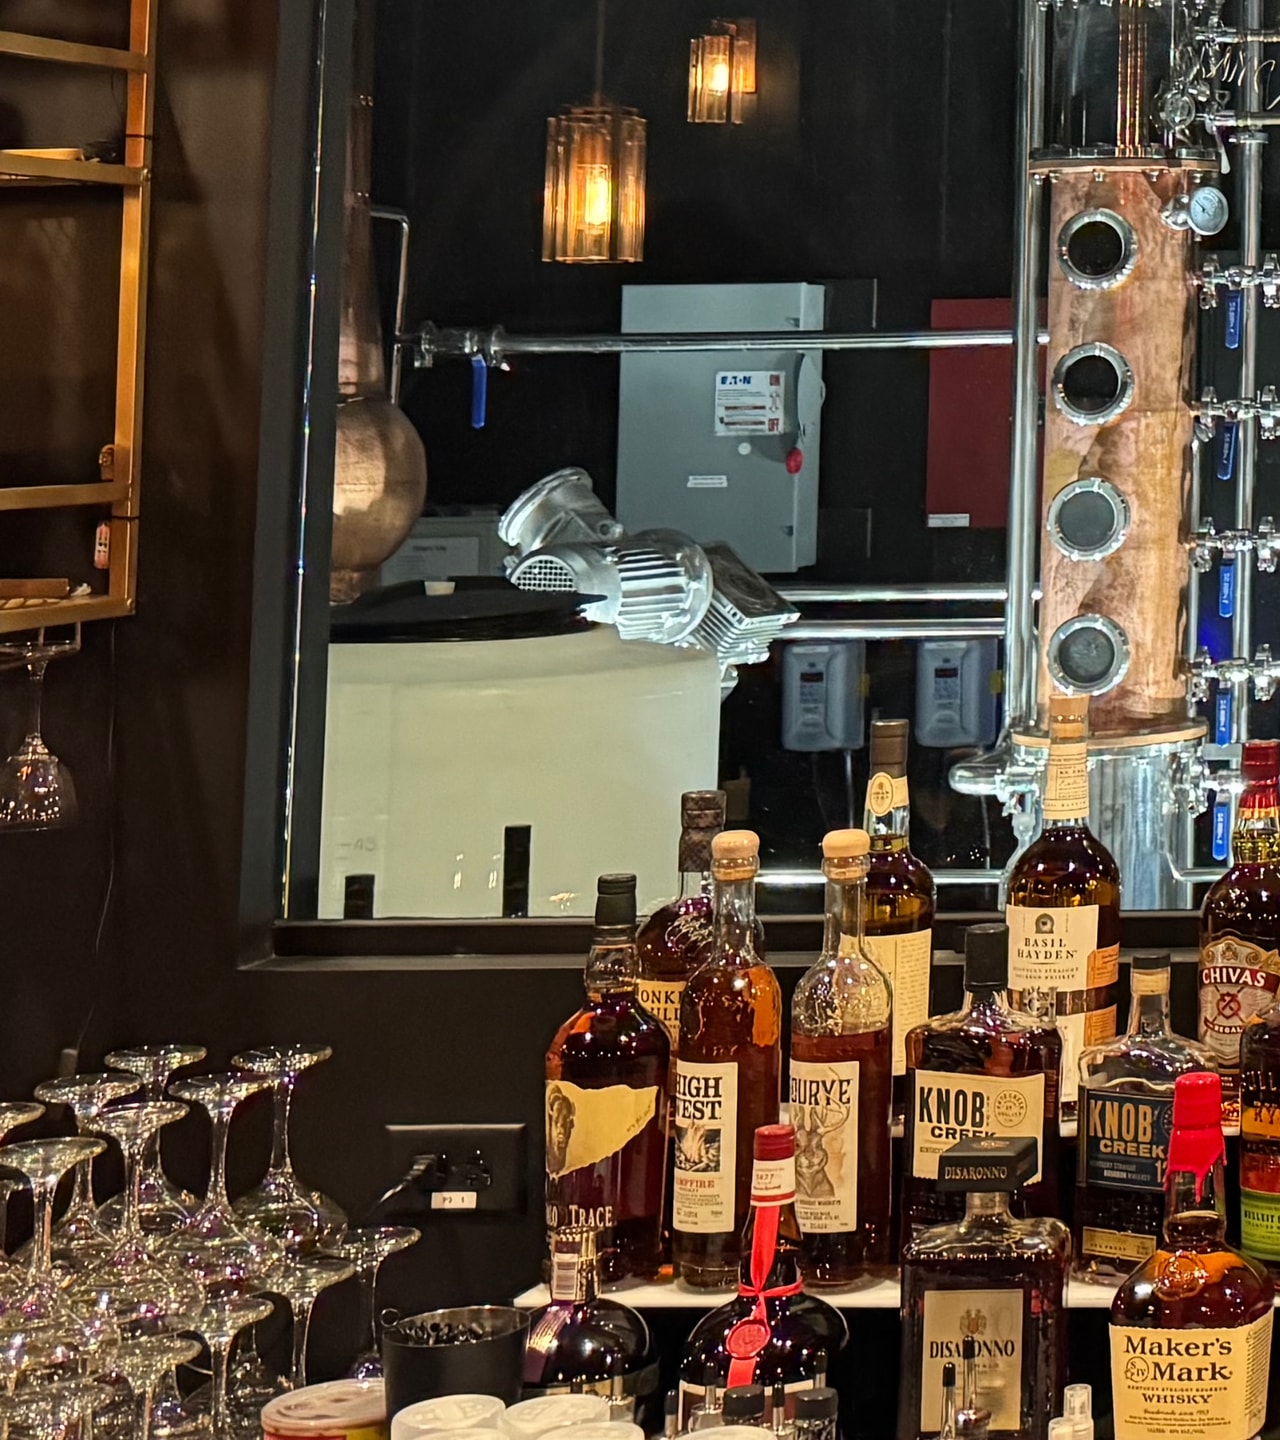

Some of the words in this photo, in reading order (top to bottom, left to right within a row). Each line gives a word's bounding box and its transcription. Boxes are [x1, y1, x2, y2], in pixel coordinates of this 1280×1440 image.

[1024, 938, 1067, 948] BASIL
[1017, 949, 1075, 960] HAYDEN
[1202, 967, 1267, 987] CHIVAS
[1214, 1025, 1243, 1035] REGAL
[790, 1078, 853, 1106] OURYE
[919, 1086, 985, 1128] KNOB
[1089, 1099, 1152, 1143] KNOB
[1100, 1140, 1165, 1158] CREEK
[945, 1166, 1008, 1180] DISARONNO
[568, 1205, 614, 1227] TRACE
[930, 1340, 1015, 1358] DISAONNO
[1123, 1335, 1232, 1356] Maker's
[1150, 1361, 1231, 1381] Mark
[1142, 1393, 1213, 1404] WHISKY
